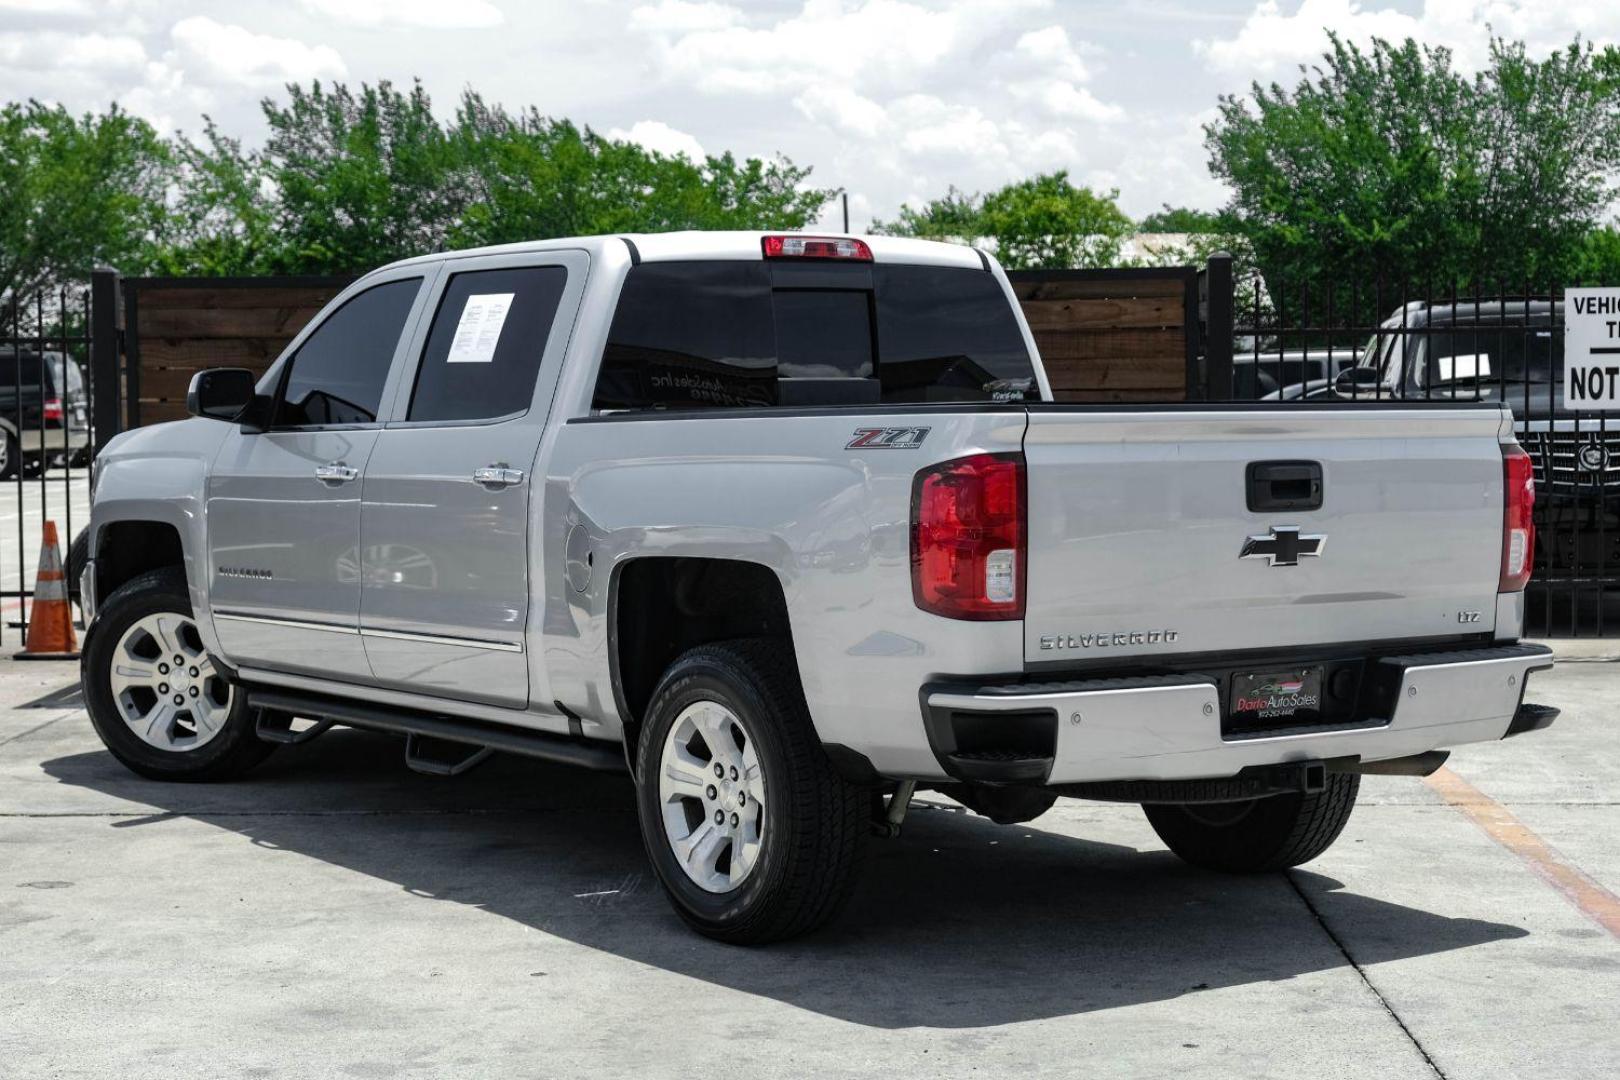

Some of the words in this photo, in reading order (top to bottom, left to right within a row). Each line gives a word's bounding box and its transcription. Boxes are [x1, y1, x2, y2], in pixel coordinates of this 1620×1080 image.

[1573, 297, 1620, 315] VEHI
[1606, 321, 1620, 338] T
[1571, 366, 1620, 400] NOT
[844, 426, 931, 450] Z71
[1458, 611, 1481, 623] LTZ
[1040, 629, 1178, 650] SILVERADO
